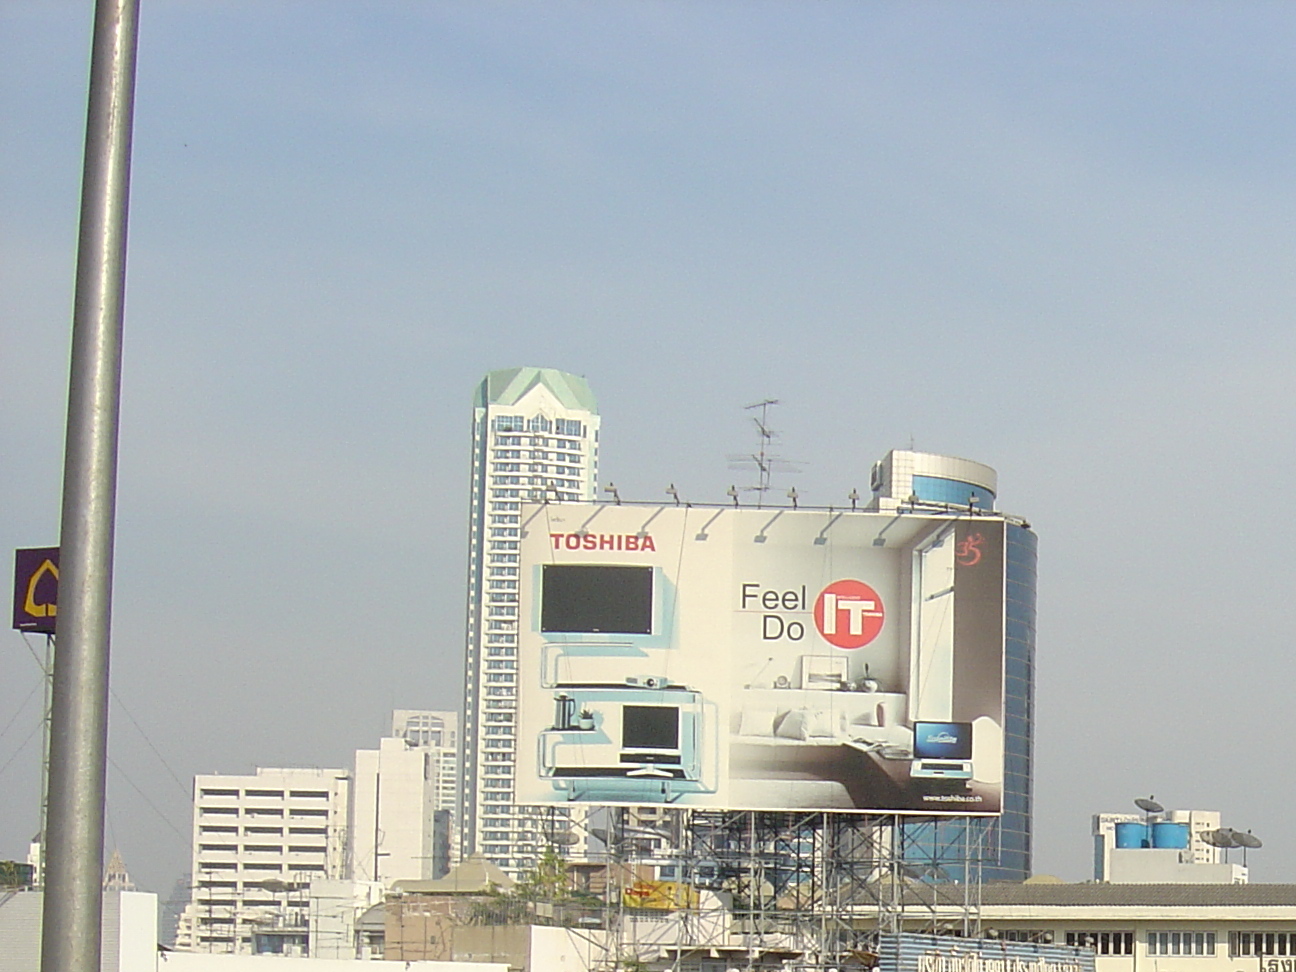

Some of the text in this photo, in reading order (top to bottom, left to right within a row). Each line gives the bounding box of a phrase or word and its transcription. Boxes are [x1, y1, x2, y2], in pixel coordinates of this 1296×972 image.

[550, 533, 656, 552] TOSHIBA
[741, 583, 806, 611] Feel
[762, 614, 805, 641] Do
[823, 593, 875, 635] IT
